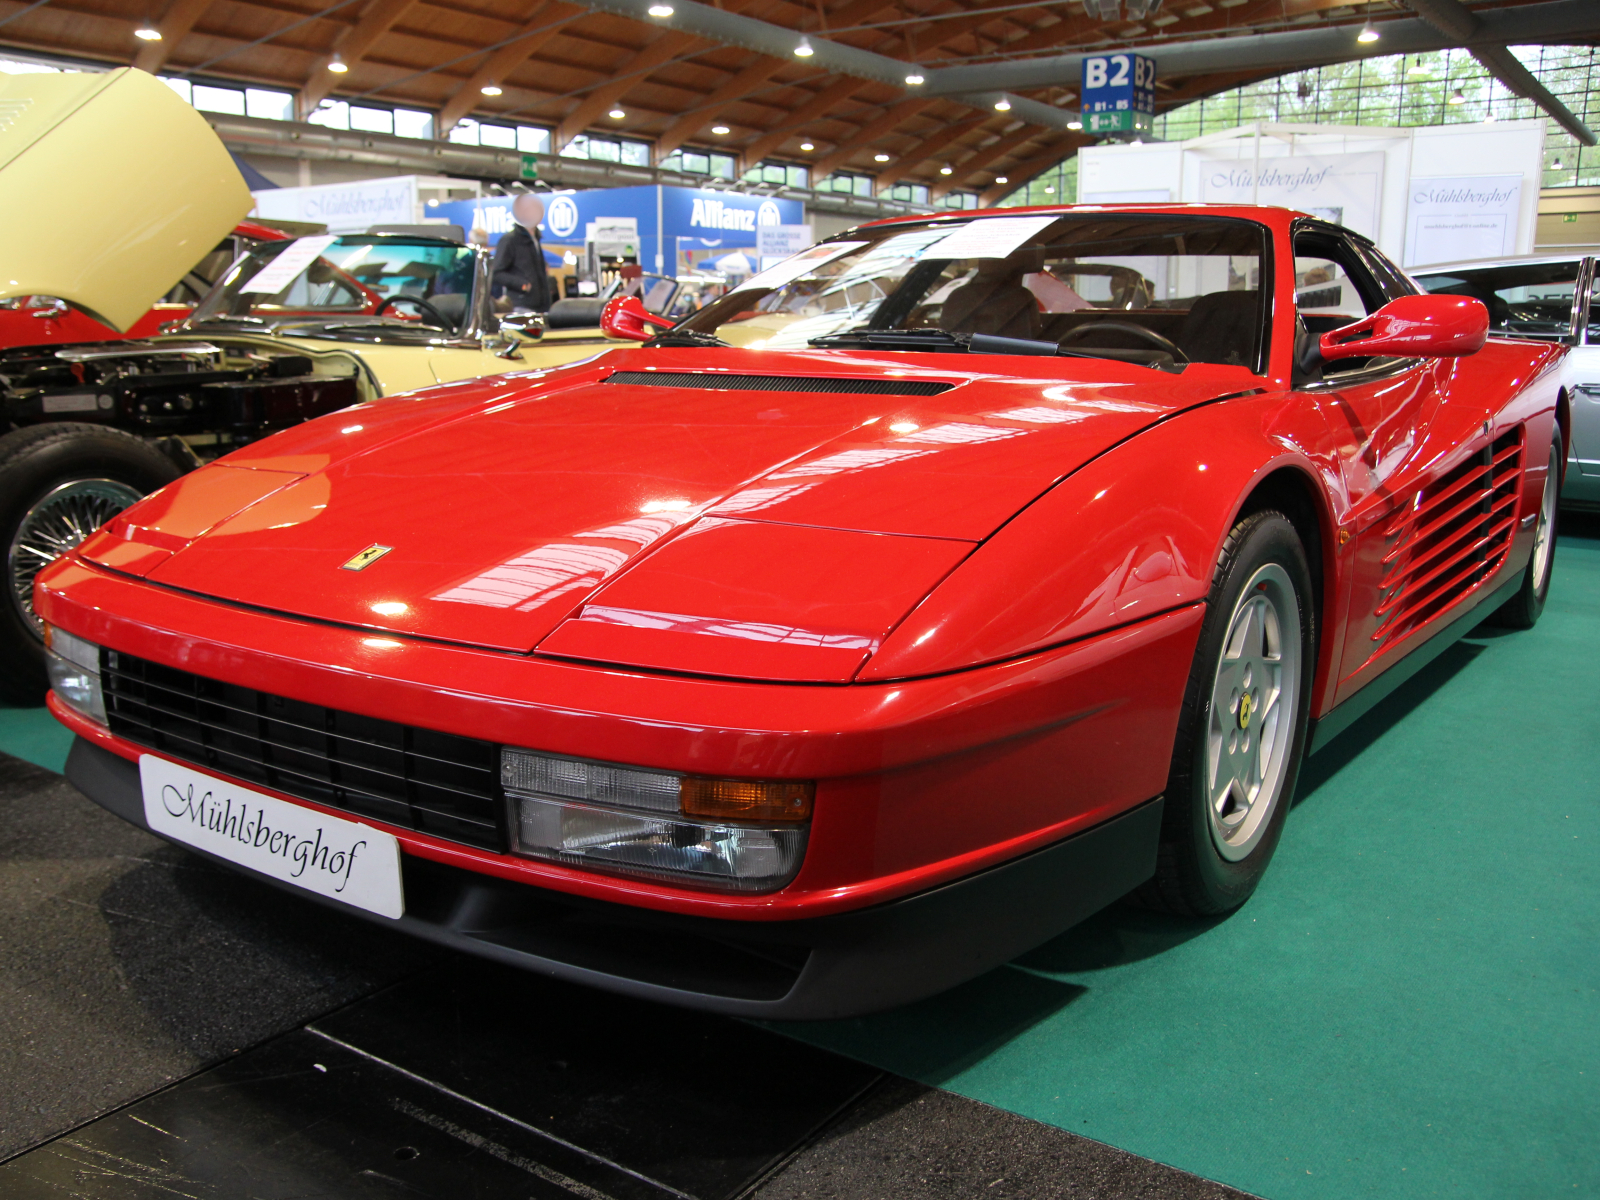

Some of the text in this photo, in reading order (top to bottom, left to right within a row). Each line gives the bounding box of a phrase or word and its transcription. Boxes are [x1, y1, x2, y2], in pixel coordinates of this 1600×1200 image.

[1086, 54, 1130, 89] B2
[1135, 56, 1154, 91] B2
[1095, 101, 1106, 111] B1
[690, 198, 756, 231] Allianz
[1414, 187, 1517, 208] Mühlsberghof
[162, 783, 367, 893] Mühlsberghof
